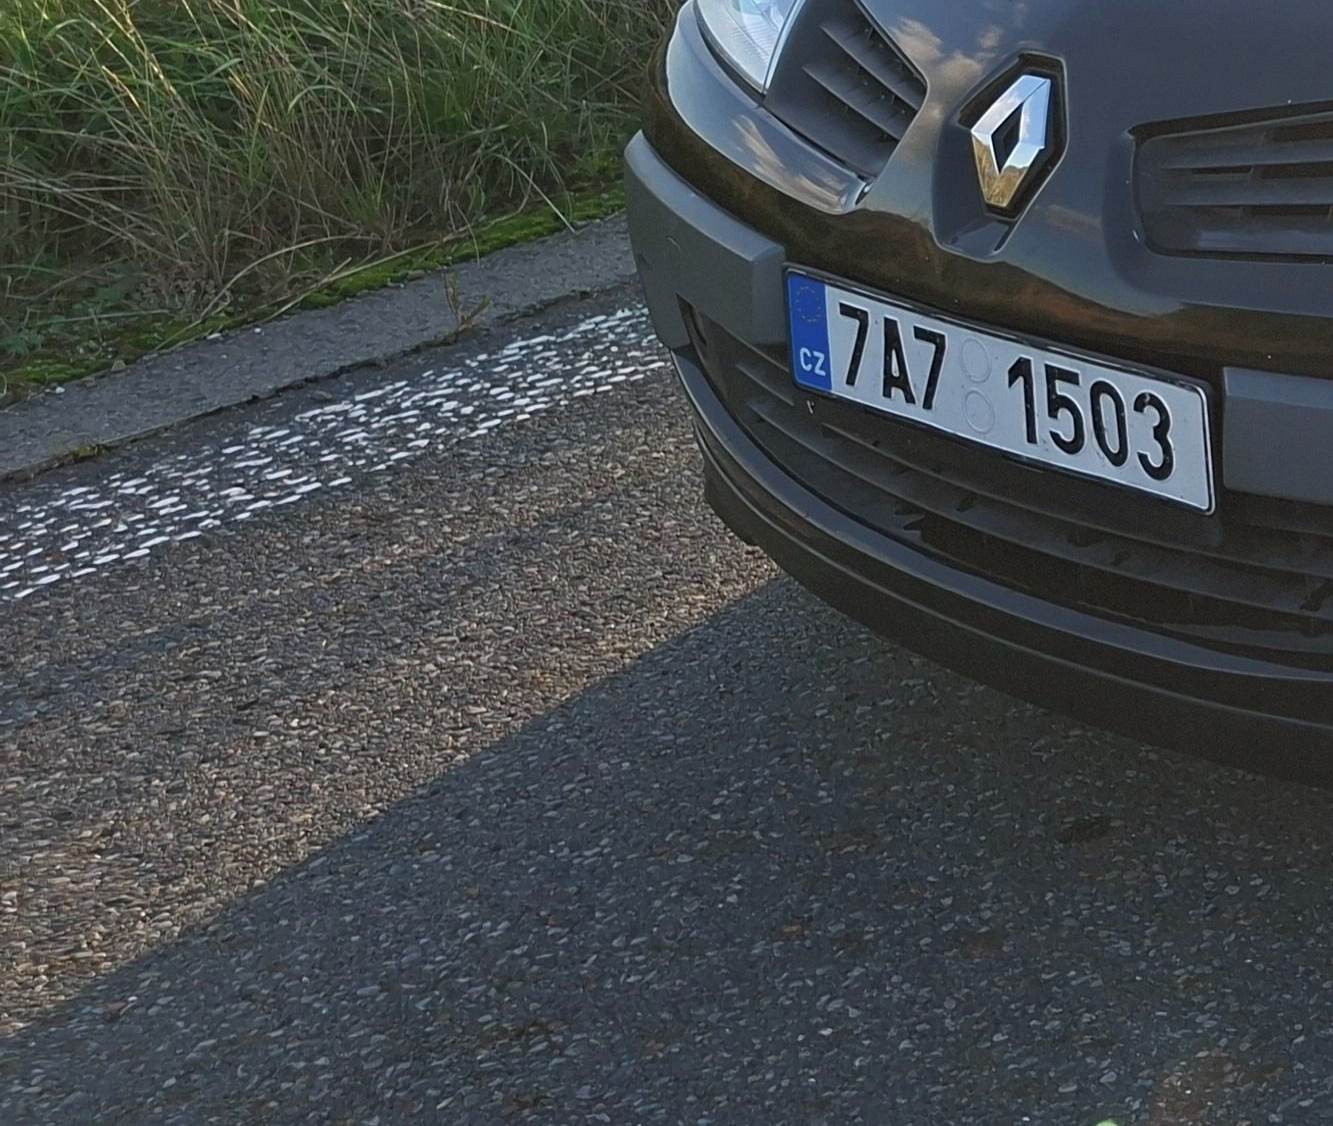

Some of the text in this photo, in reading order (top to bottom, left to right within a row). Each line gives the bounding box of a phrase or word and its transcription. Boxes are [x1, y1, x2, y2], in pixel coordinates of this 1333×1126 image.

[799, 347, 827, 377] CZ
[839, 302, 1175, 481] 7A7 1503
